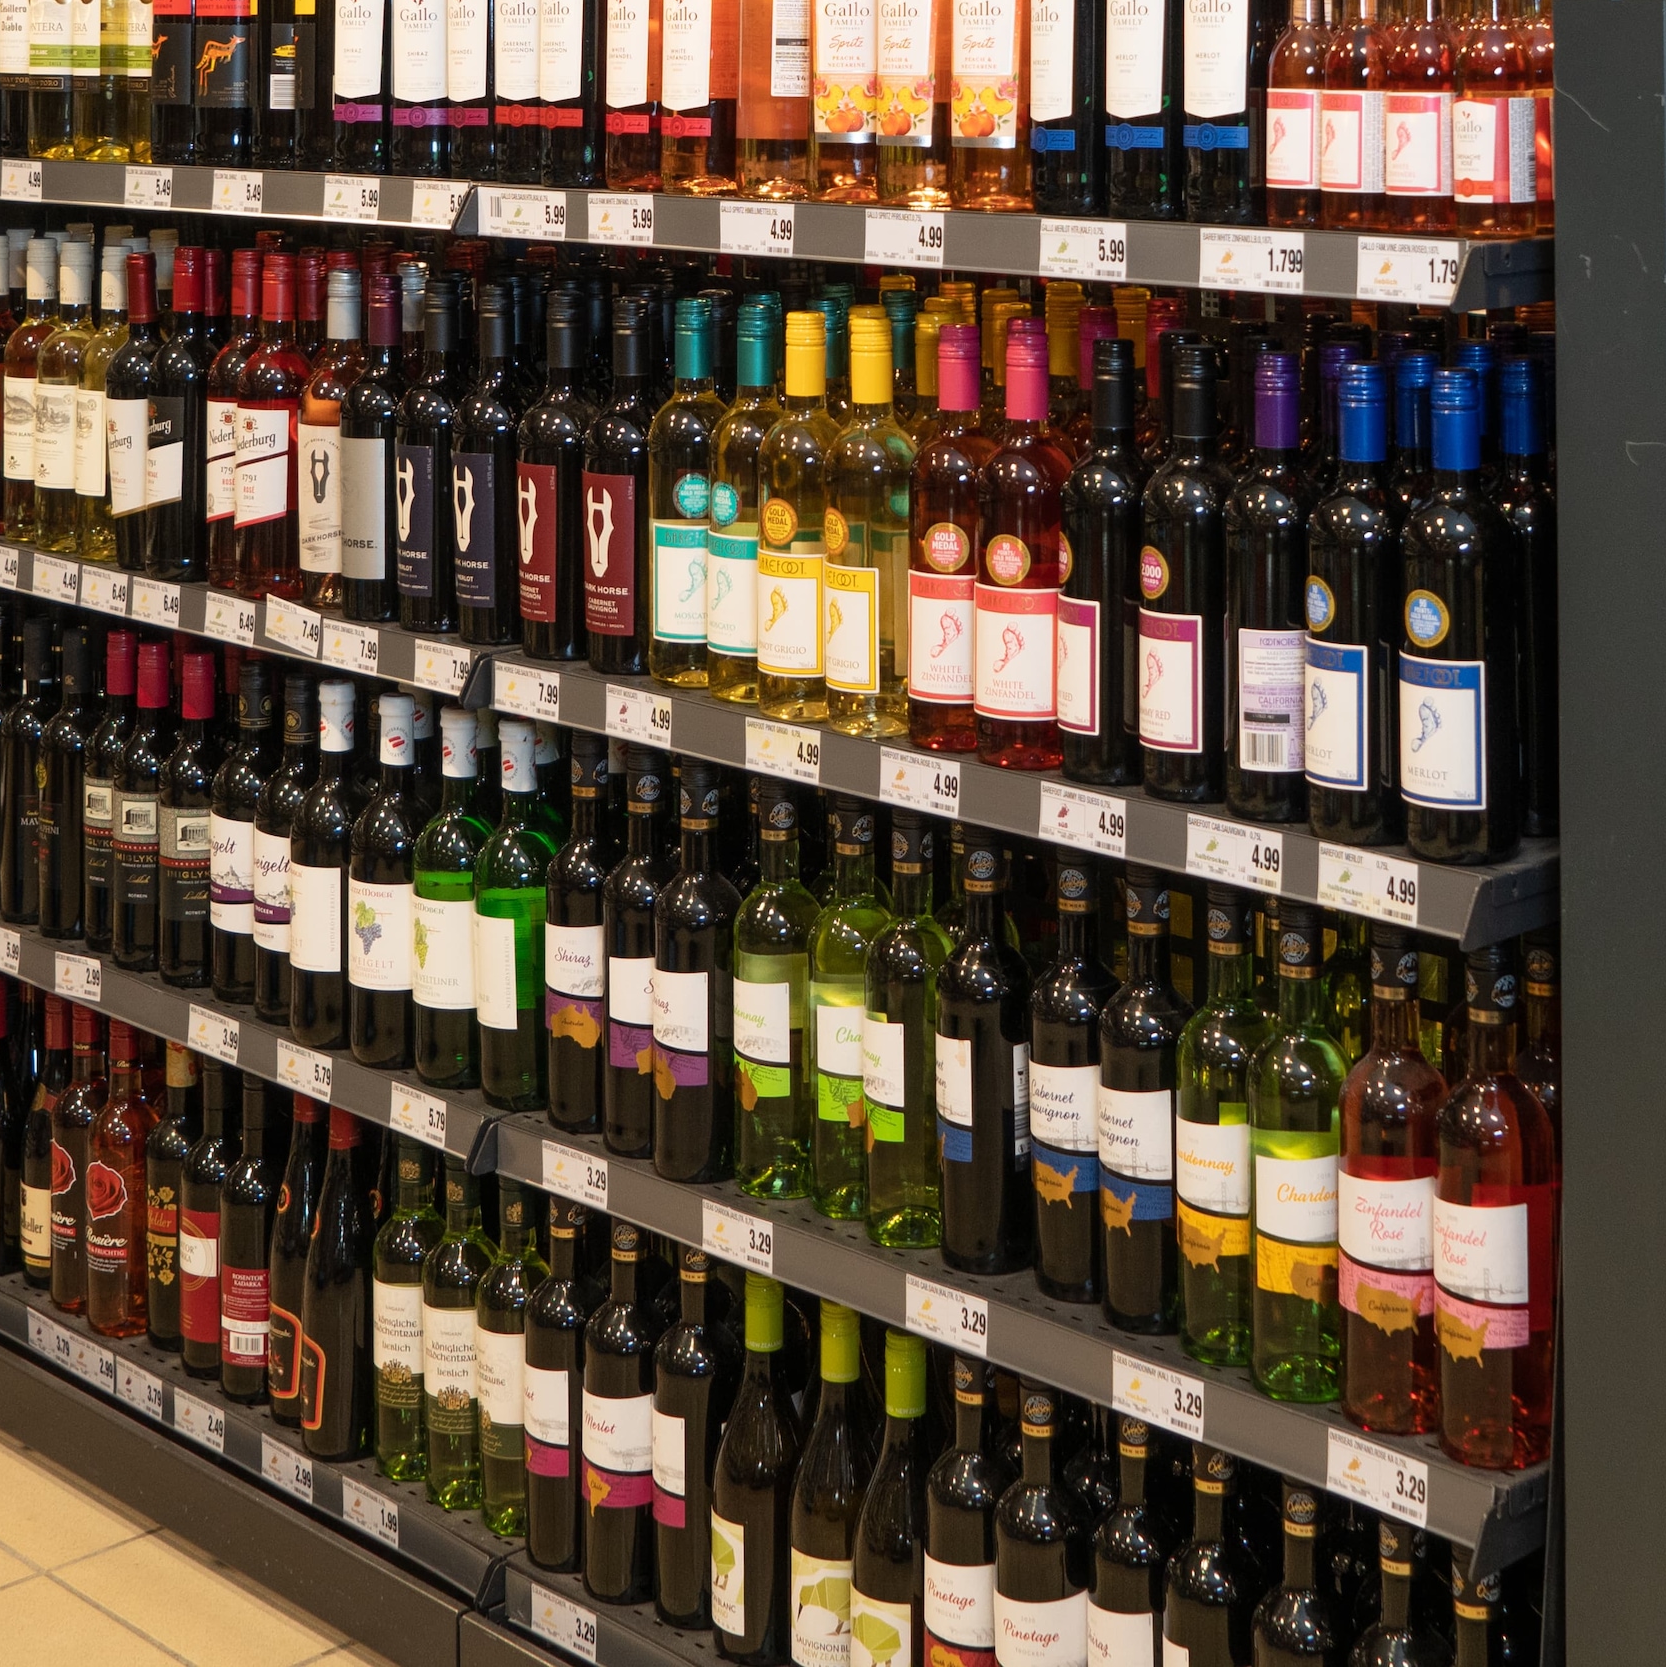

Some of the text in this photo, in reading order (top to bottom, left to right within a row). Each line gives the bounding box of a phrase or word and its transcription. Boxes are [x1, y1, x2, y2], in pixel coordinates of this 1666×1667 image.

[338, 5, 371, 19] Gallo
[399, 7, 437, 23] Gallo
[500, 2, 536, 16] Gallo
[665, 7, 697, 21] Gallo
[824, 2, 870, 17] Gallo
[880, 2, 918, 17] Gallo
[958, 0, 1001, 17] Gallo
[828, 34, 864, 49] Spritz
[883, 35, 912, 50] Spritz
[962, 34, 996, 49] Spritz
[1455, 120, 1482, 133] Gallo
[155, 179, 171, 196] 5.49
[246, 184, 261, 202] 5.49
[361, 189, 378, 208] 5.99
[545, 205, 565, 225] 5.99
[632, 209, 652, 229] 5.99
[770, 219, 792, 240] 4.99
[918, 226, 942, 248] 4.99
[1098, 239, 1125, 262] 5.99
[1268, 249, 1303, 273] 1.799
[1428, 259, 1458, 284] 1.79
[241, 473, 257, 482] 1791
[243, 484, 255, 494] ROSÉ
[767, 517, 788, 526] MEDAL
[769, 509, 785, 518] GOLD
[932, 540, 960, 551] MEDAL
[934, 532, 957, 542] GOLD
[402, 550, 427, 560] HORSE
[4, 558, 17, 575] 4.49
[465, 560, 489, 570] HORSE
[62, 573, 76, 590] 4.49
[527, 572, 551, 583] HORSE
[112, 582, 126, 602] 6.49
[596, 586, 629, 596] HORSE
[163, 594, 179, 613] 6.49
[587, 604, 618, 613] SAUVIGNON
[588, 597, 616, 607] CABERNET
[239, 613, 254, 632] 6.49
[302, 619, 319, 642] 7.49
[360, 639, 377, 660] 7.99
[779, 644, 807, 655] GRIGIO
[452, 660, 470, 681] 7.99
[921, 671, 973, 683] ZINFANDEL
[930, 664, 963, 674] WHITE
[538, 683, 558, 705] 7.99
[992, 679, 1024, 690] WHITE
[984, 688, 1036, 701] ZINFANDEL
[1258, 695, 1303, 706] CALIFORNIA
[651, 708, 670, 731] 4.99
[1154, 710, 1171, 721] RED
[797, 742, 819, 766] 4.99
[1408, 766, 1449, 781] MERLOT
[934, 773, 958, 798] 4.99
[1099, 810, 1124, 838] 4.99
[1252, 844, 1280, 873] 4.99
[1386, 875, 1416, 906] 4.99
[6, 941, 19, 961] 5.99
[553, 945, 593, 967] Shiraz
[86, 967, 100, 986] 2.99
[222, 1028, 239, 1049] 3.99
[314, 1064, 332, 1086] 5.79
[428, 1106, 446, 1131] 5.79
[587, 1165, 606, 1191] 3.29
[1355, 1195, 1423, 1219] Zinfandel
[86, 1227, 127, 1248] Rosière
[1369, 1219, 1405, 1241] Rosé
[749, 1229, 772, 1255] 3.29
[94, 1248, 125, 1257] FRUCHTIG
[1440, 1245, 1468, 1267] Rosé
[1368, 1300, 1410, 1315] California
[961, 1307, 986, 1336] 3.29
[56, 1335, 70, 1357] 3.79
[99, 1358, 113, 1380] 2.99
[147, 1385, 162, 1408] 3.79
[1174, 1388, 1202, 1419] 3.29
[207, 1415, 223, 1438] 2.49
[584, 1412, 617, 1435] Merlot
[295, 1465, 312, 1489] 2.99
[1396, 1469, 1426, 1504] 3.29
[379, 1508, 398, 1534] 1.99
[927, 1577, 976, 1608] Pinotage
[575, 1617, 596, 1644] 3.29
[1003, 1618, 1059, 1647] Pinotage
[796, 1634, 841, 1653] SAUVIGNON
[802, 1646, 818, 1659] NEW
